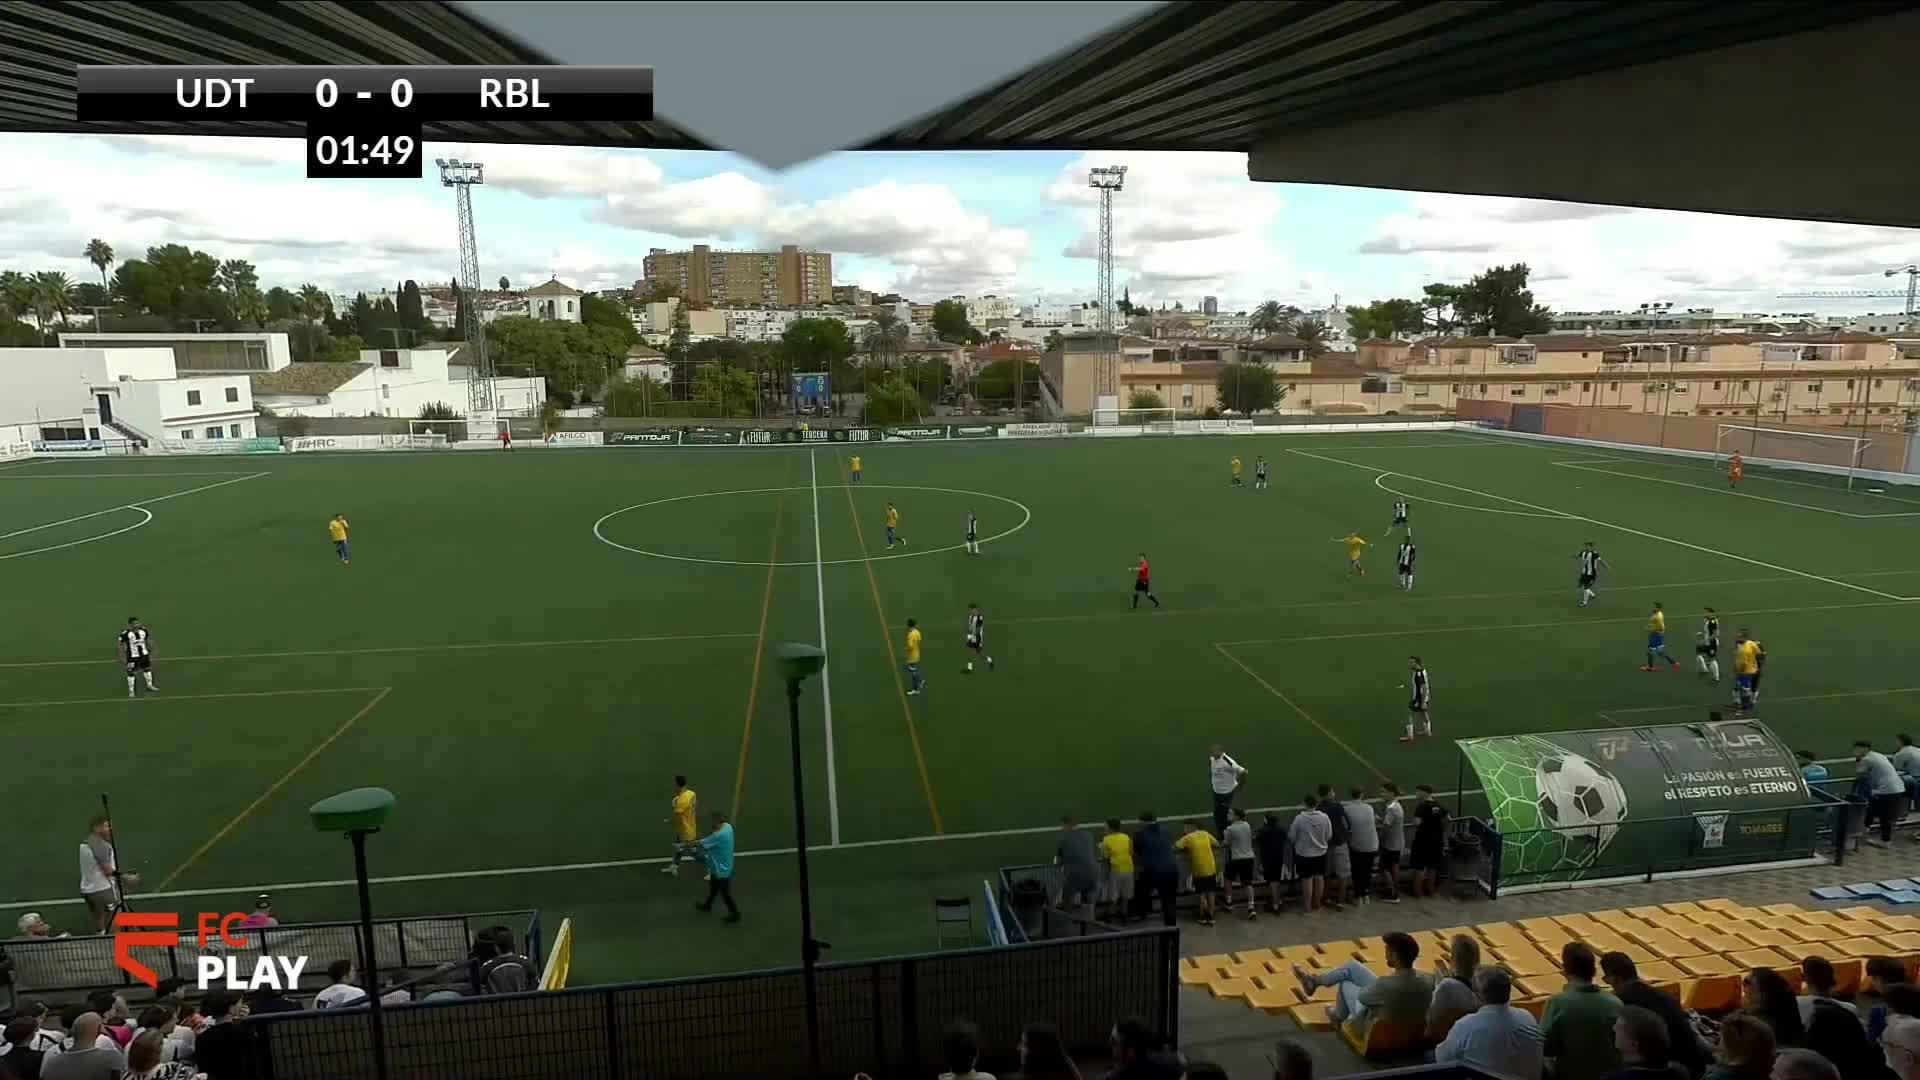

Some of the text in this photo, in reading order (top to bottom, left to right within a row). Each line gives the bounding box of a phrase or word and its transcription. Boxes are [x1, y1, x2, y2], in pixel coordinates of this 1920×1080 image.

[802, 430, 828, 439] TERCERA
[1664, 781, 1798, 800] el RESPETO es ETERNO
